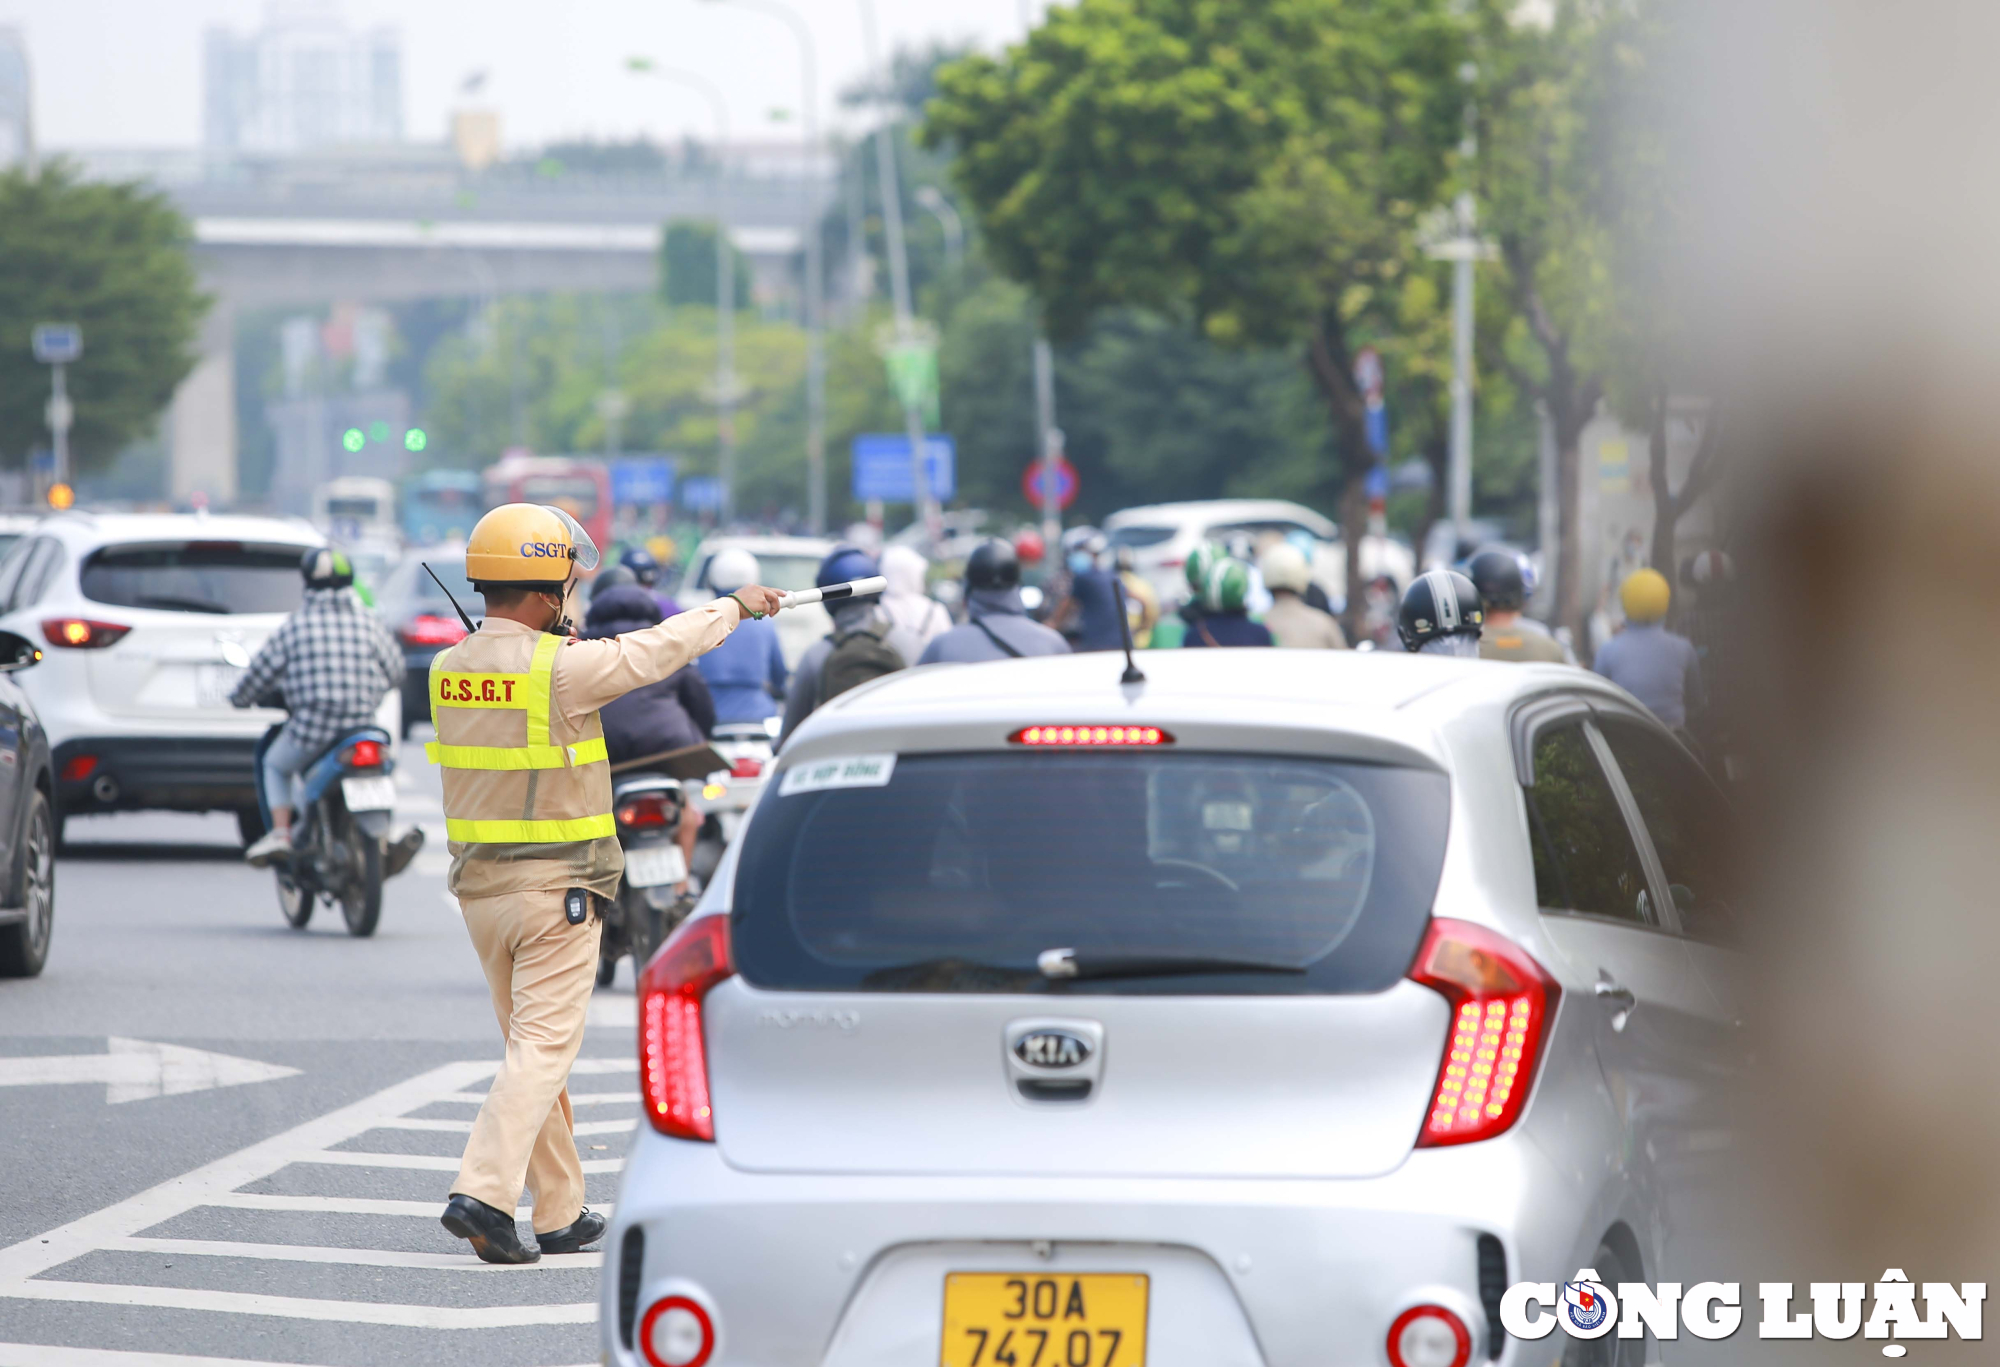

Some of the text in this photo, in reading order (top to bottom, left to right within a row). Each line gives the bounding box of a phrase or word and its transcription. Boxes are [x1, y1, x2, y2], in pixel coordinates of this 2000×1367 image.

[520, 542, 567, 559] CSGT
[440, 678, 516, 702] C.S.G.T
[1024, 1035, 1081, 1064] KIA
[1003, 1279, 1086, 1321] 30A
[966, 1329, 1123, 1367] 747.07
